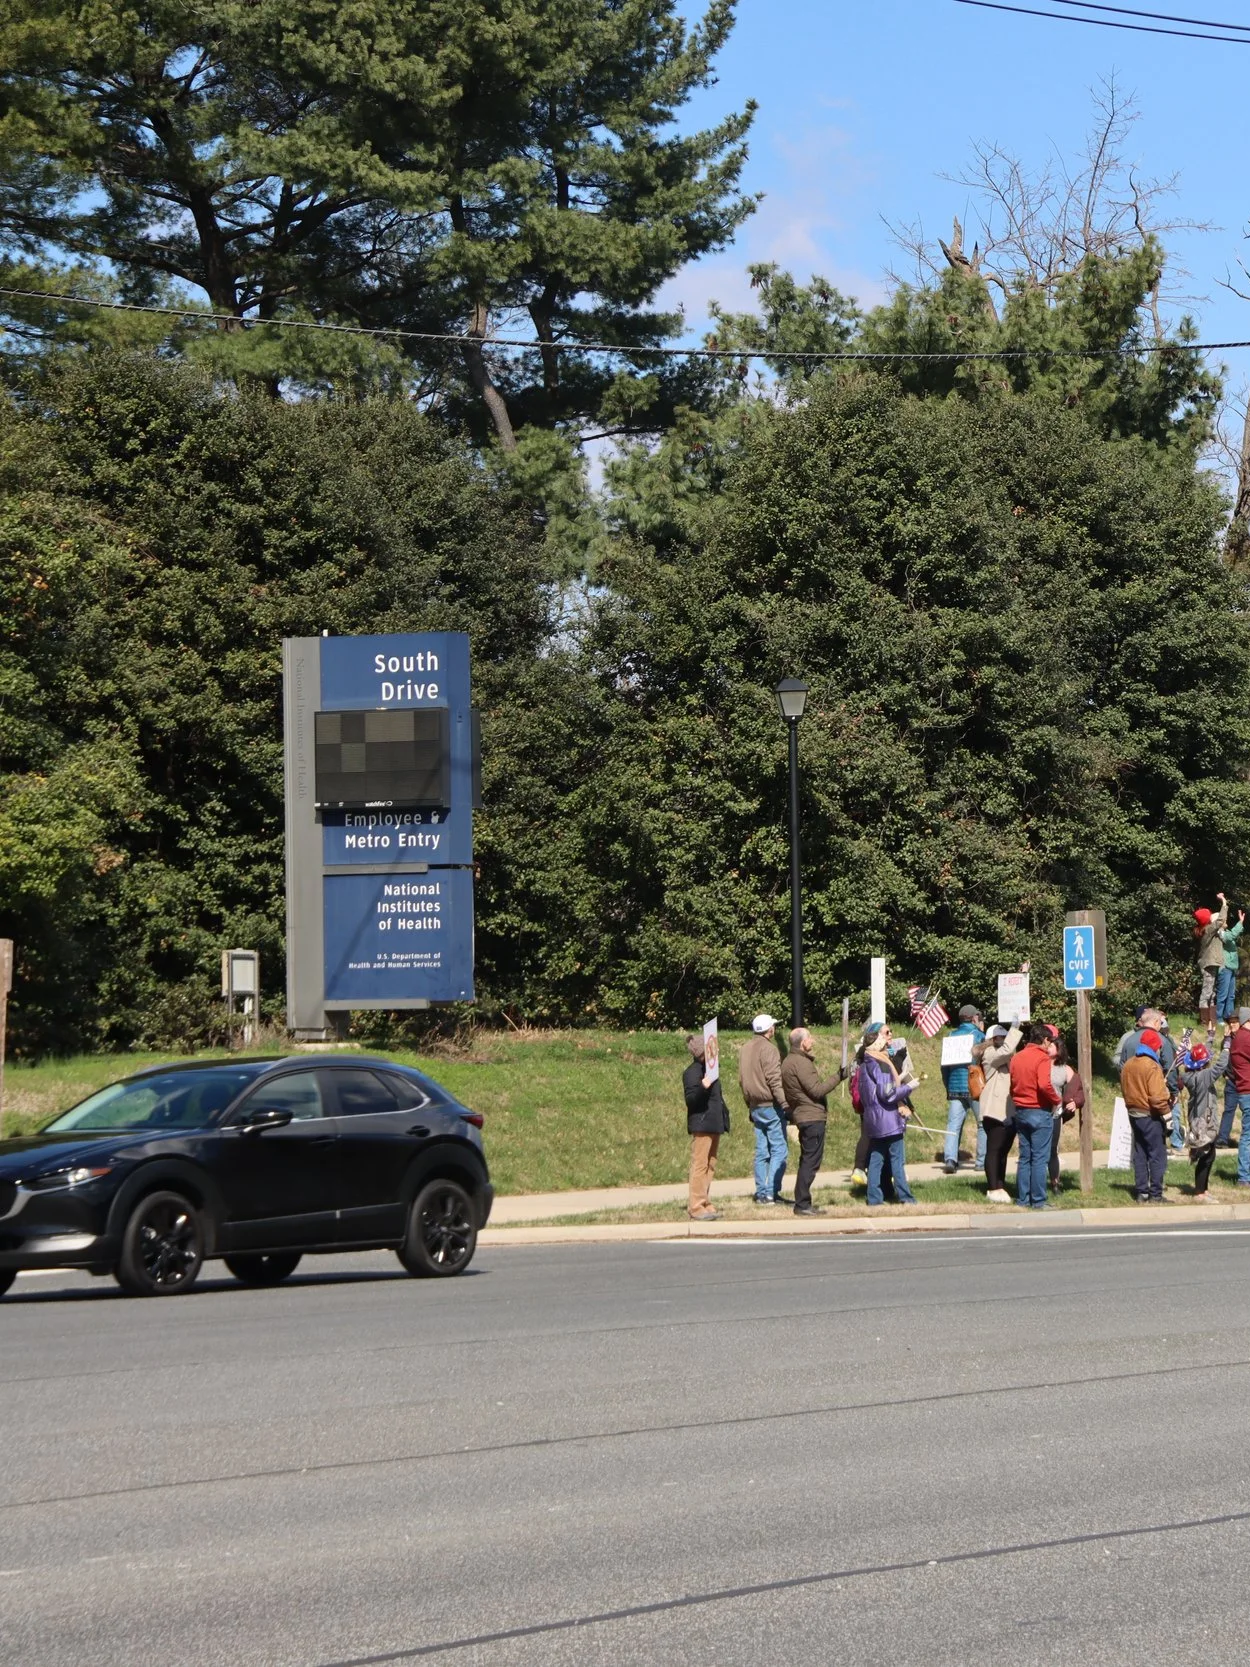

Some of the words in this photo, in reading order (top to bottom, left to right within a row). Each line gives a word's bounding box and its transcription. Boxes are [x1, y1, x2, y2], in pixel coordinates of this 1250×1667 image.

[374, 651, 439, 673] South
[296, 657, 305, 701] National
[381, 680, 439, 701] Drive
[296, 704, 305, 749] Institutes
[297, 752, 306, 763] of
[297, 766, 307, 801] Health
[345, 812, 422, 829] Employee
[345, 833, 390, 848] Metro
[398, 833, 440, 849] Entry
[384, 882, 440, 896] National
[377, 900, 441, 913] Institutes
[378, 918, 392, 930] of
[398, 917, 441, 930] Health
[392, 952, 431, 961] Department
[373, 961, 386, 969] and
[1068, 959, 1090, 970] CVIF
